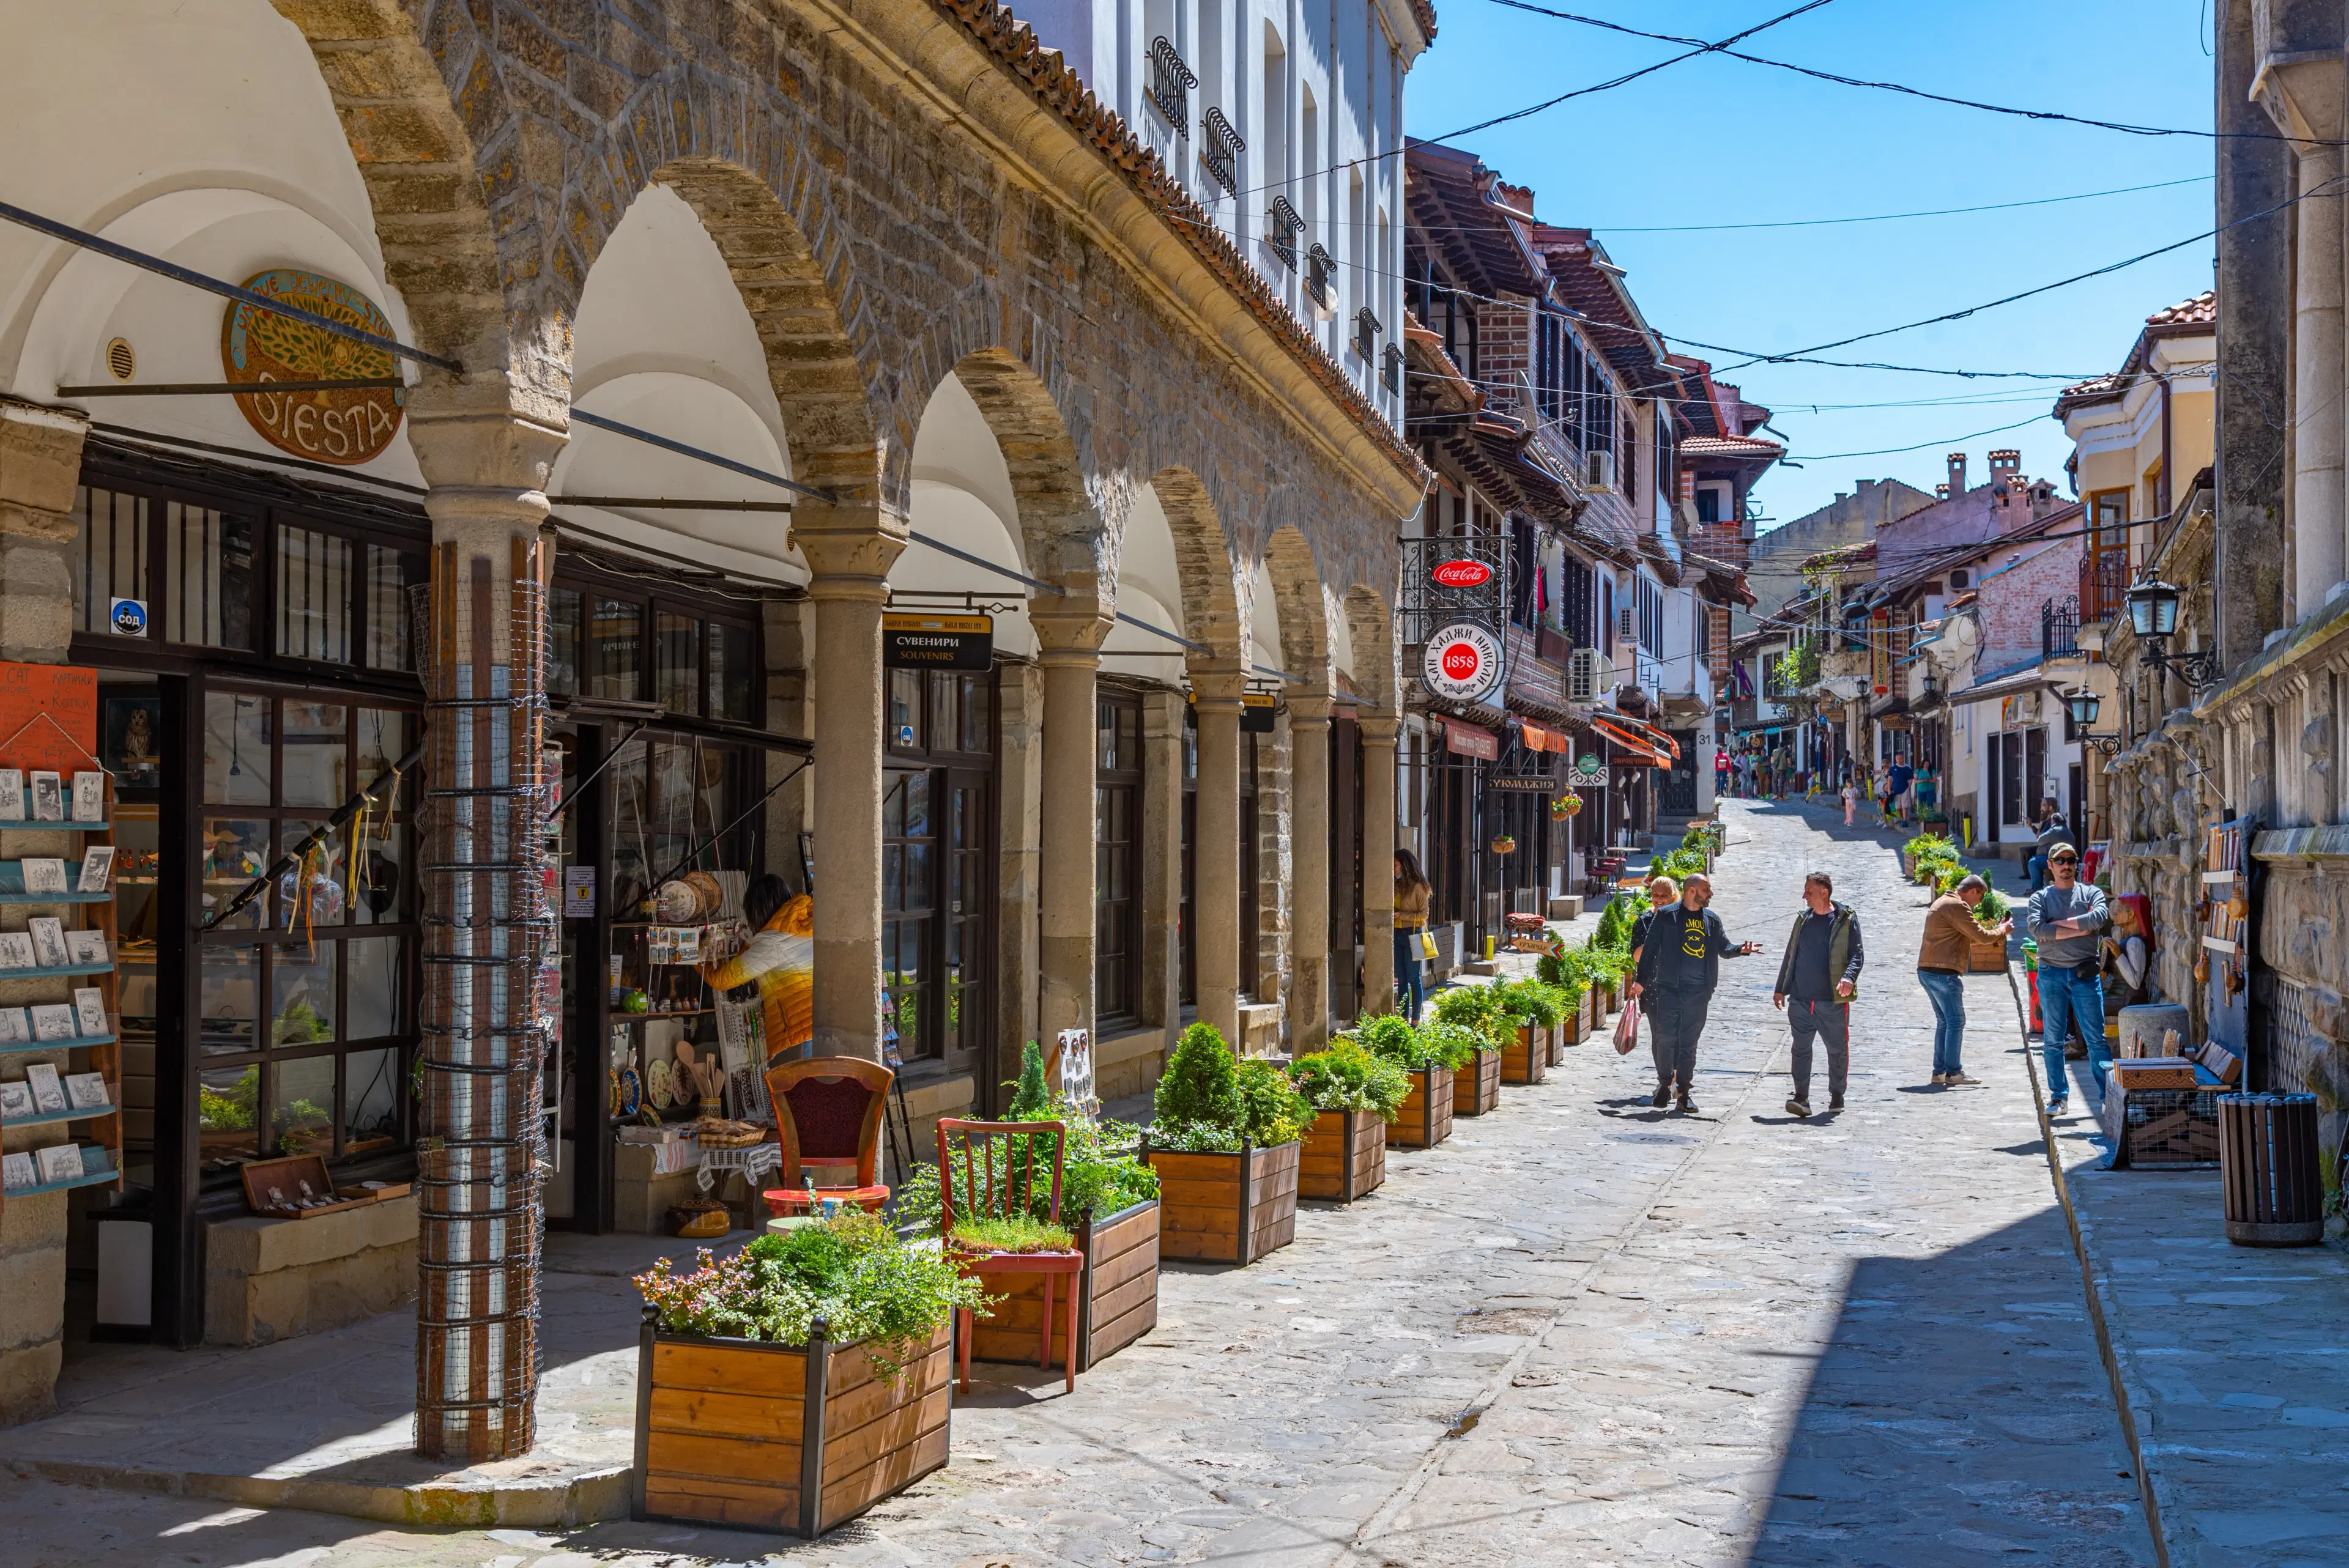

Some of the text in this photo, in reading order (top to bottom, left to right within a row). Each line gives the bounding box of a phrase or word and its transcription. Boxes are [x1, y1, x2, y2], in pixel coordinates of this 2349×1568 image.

[289, 272, 352, 306] JEWELRY
[253, 371, 393, 457] SIESTA
[1439, 566, 1484, 580] Coca-Cola
[118, 614, 140, 627] СОД
[896, 637, 959, 647] СУВЕНИРИ
[900, 651, 954, 661] SOUVENIRS
[1427, 628, 1494, 686] ХАН ХАДЖИ НИКОЛИ
[1445, 655, 1475, 668] 1858
[7, 667, 32, 684] CAT
[1699, 734, 1710, 745] 31
[1685, 919, 1705, 930] MOU
[1519, 941, 1547, 951] ГРЪНЧАР
